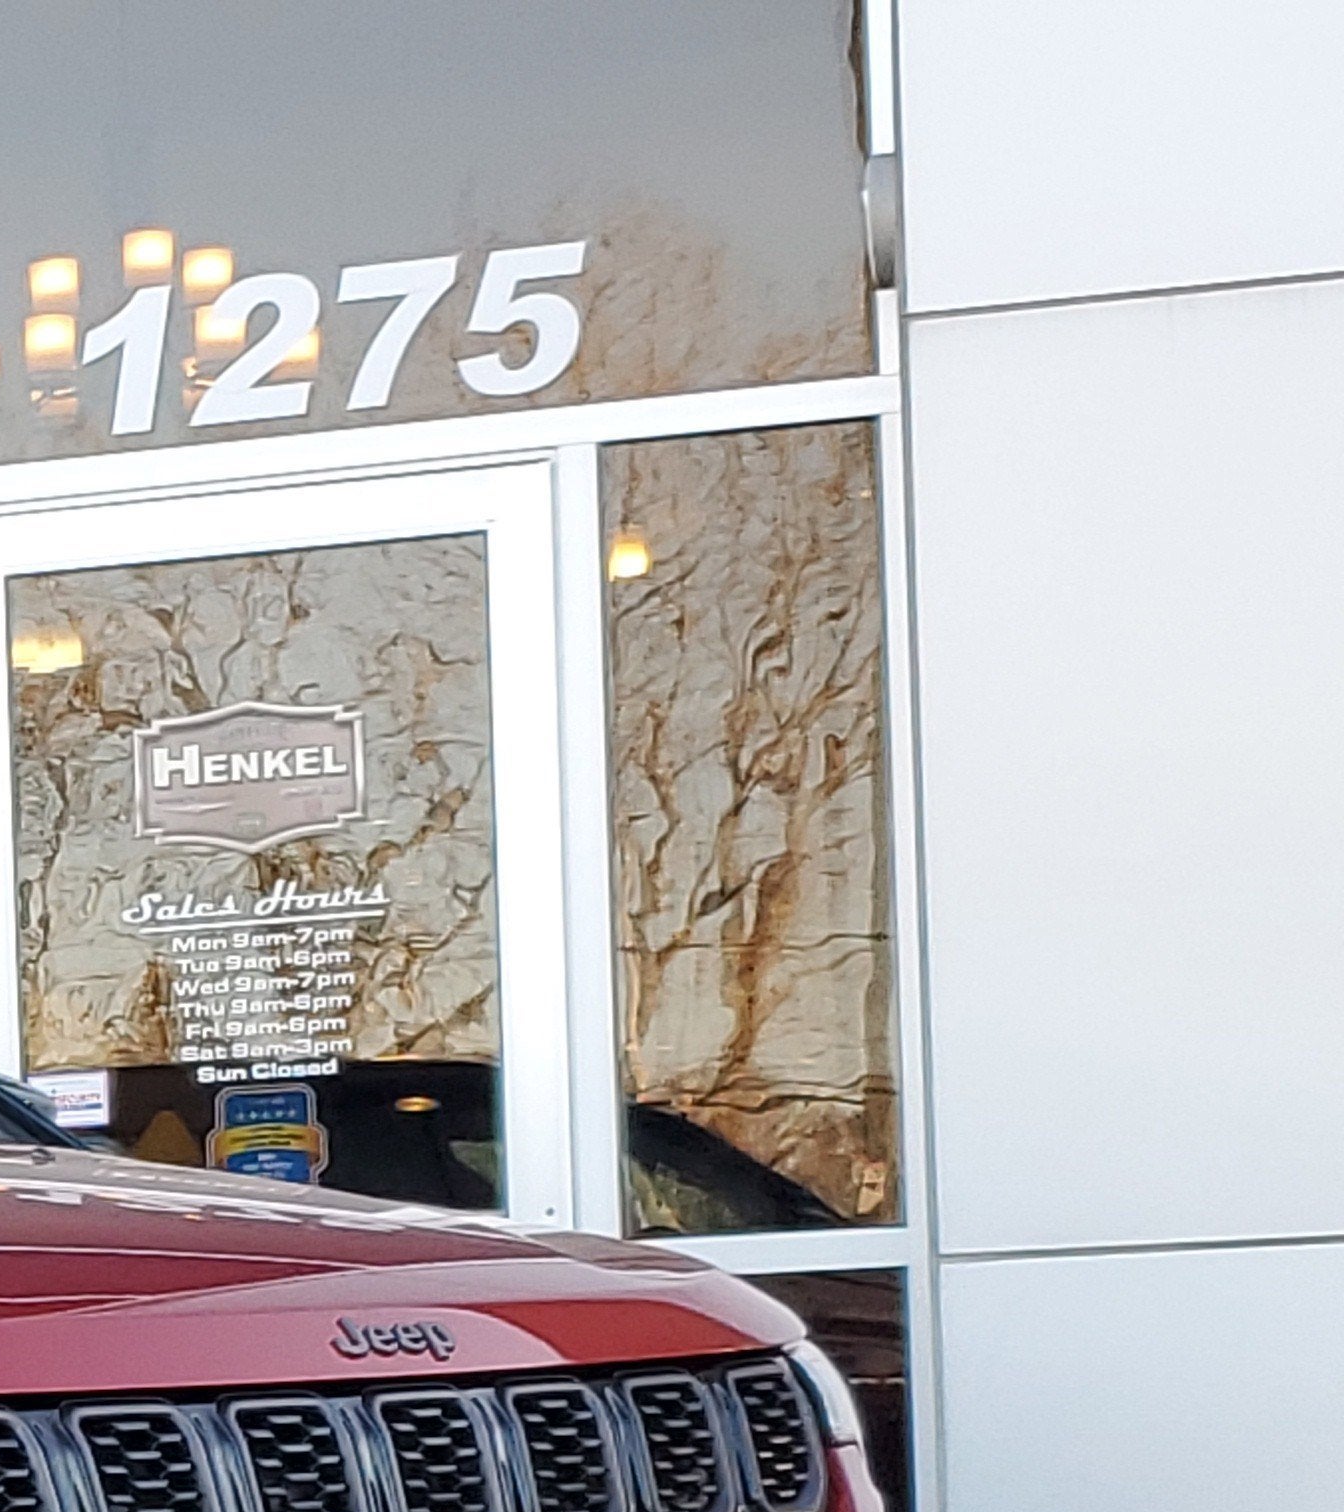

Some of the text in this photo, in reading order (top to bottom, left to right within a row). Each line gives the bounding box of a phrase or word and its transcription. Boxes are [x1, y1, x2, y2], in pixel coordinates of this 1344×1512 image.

[81, 240, 586, 436] 1275
[152, 743, 348, 788] HENKEL
[122, 879, 390, 923] Sales Hours
[172, 927, 353, 953] Mon 9am-7pm
[172, 977, 230, 997] Wed
[178, 1002, 225, 1018] Thu
[185, 1023, 219, 1040] Fri
[180, 1045, 227, 1062] Sat
[197, 1057, 338, 1084] Sun Closed
[330, 1317, 455, 1362] Jeep
